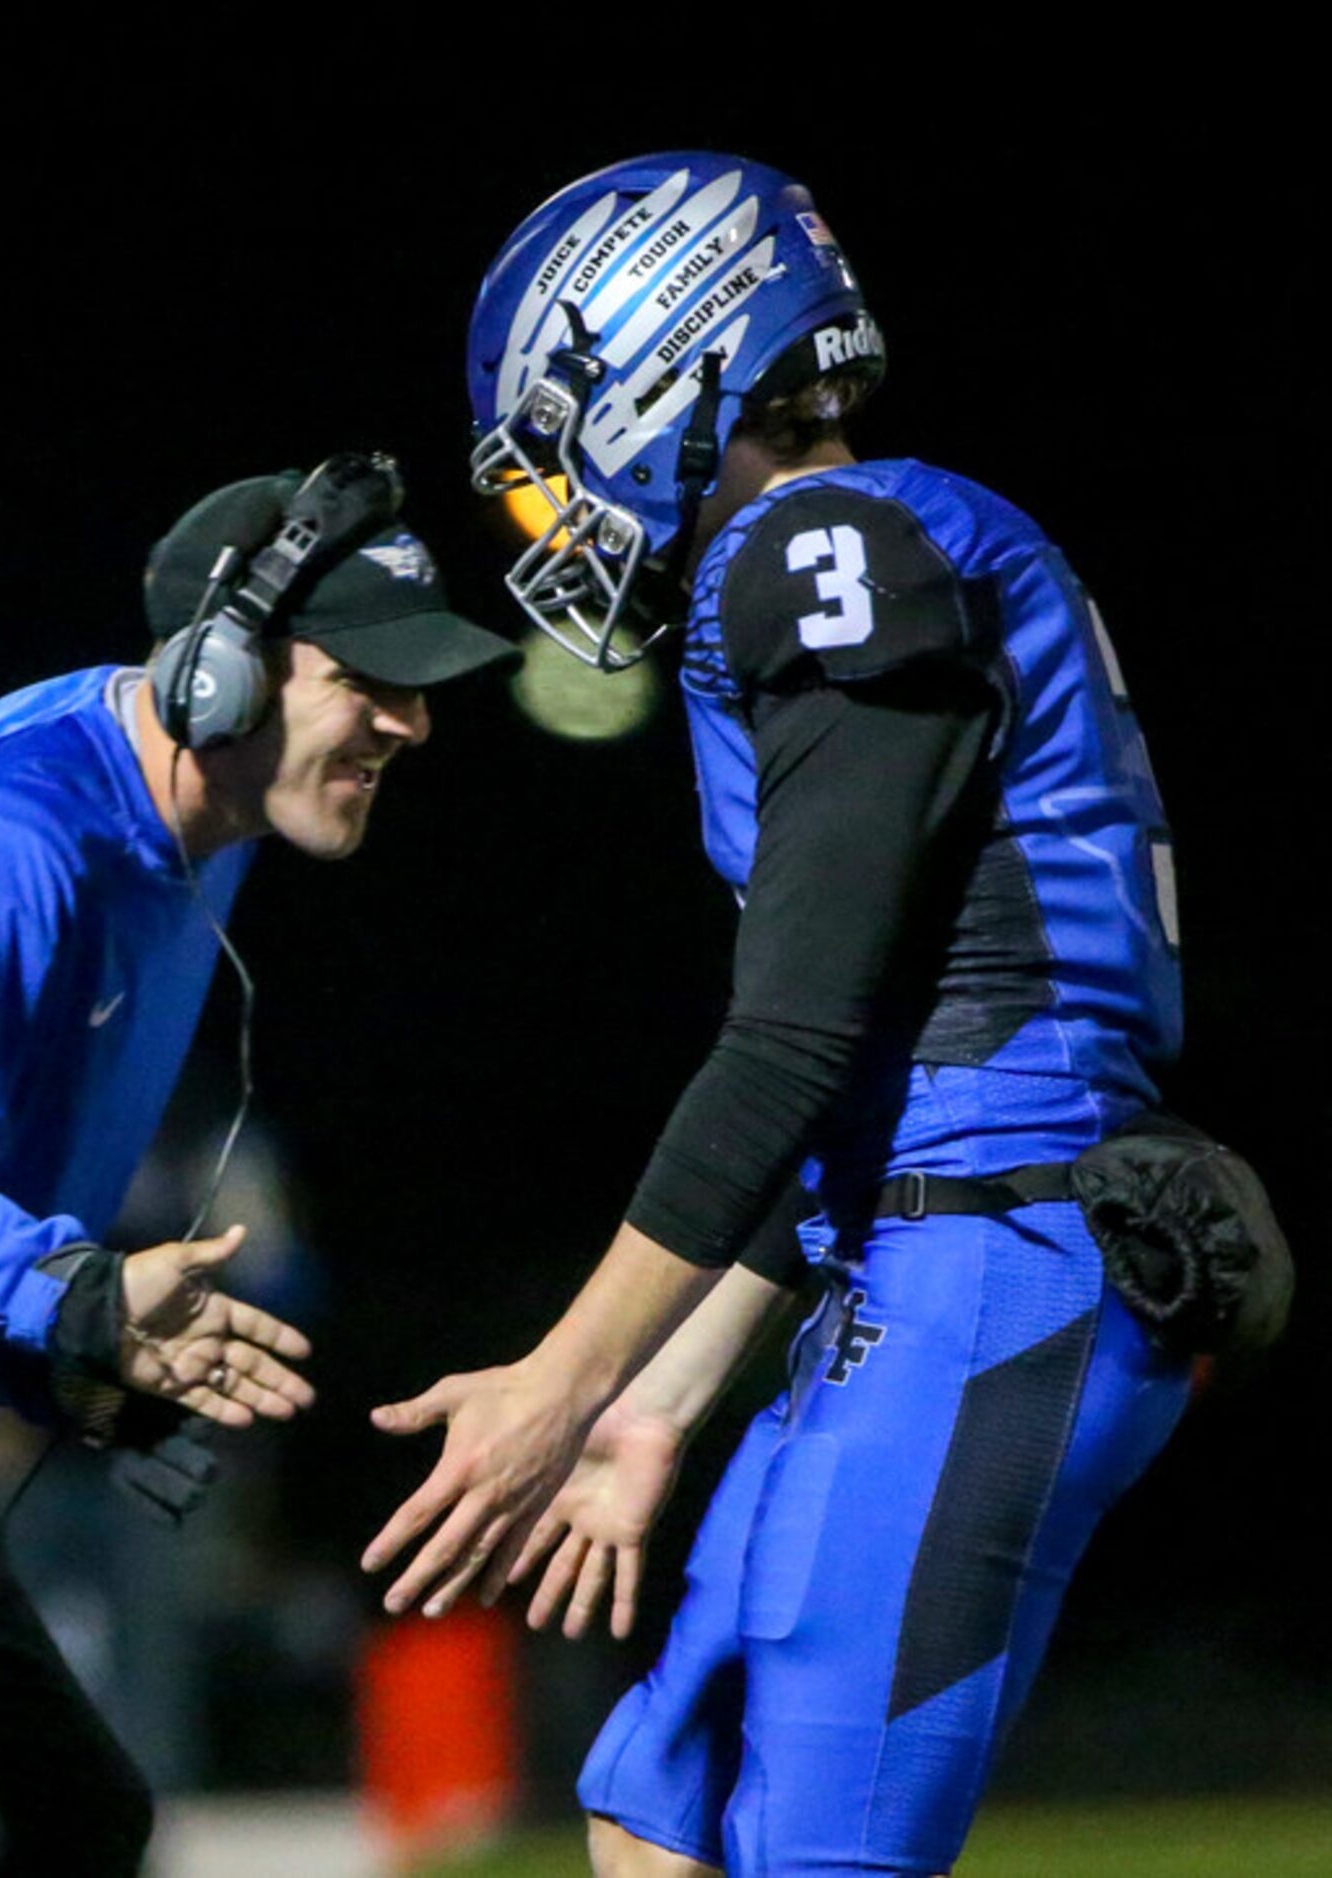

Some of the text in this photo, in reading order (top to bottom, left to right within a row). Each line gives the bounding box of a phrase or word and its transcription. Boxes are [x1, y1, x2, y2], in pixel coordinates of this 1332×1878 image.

[537, 233, 580, 295] JUICE
[573, 207, 653, 293] COMPETE
[627, 220, 691, 277] TOUGH
[656, 237, 725, 310] FAMILY
[657, 267, 759, 364] DISCIPLINE
[785, 525, 874, 650] 3
